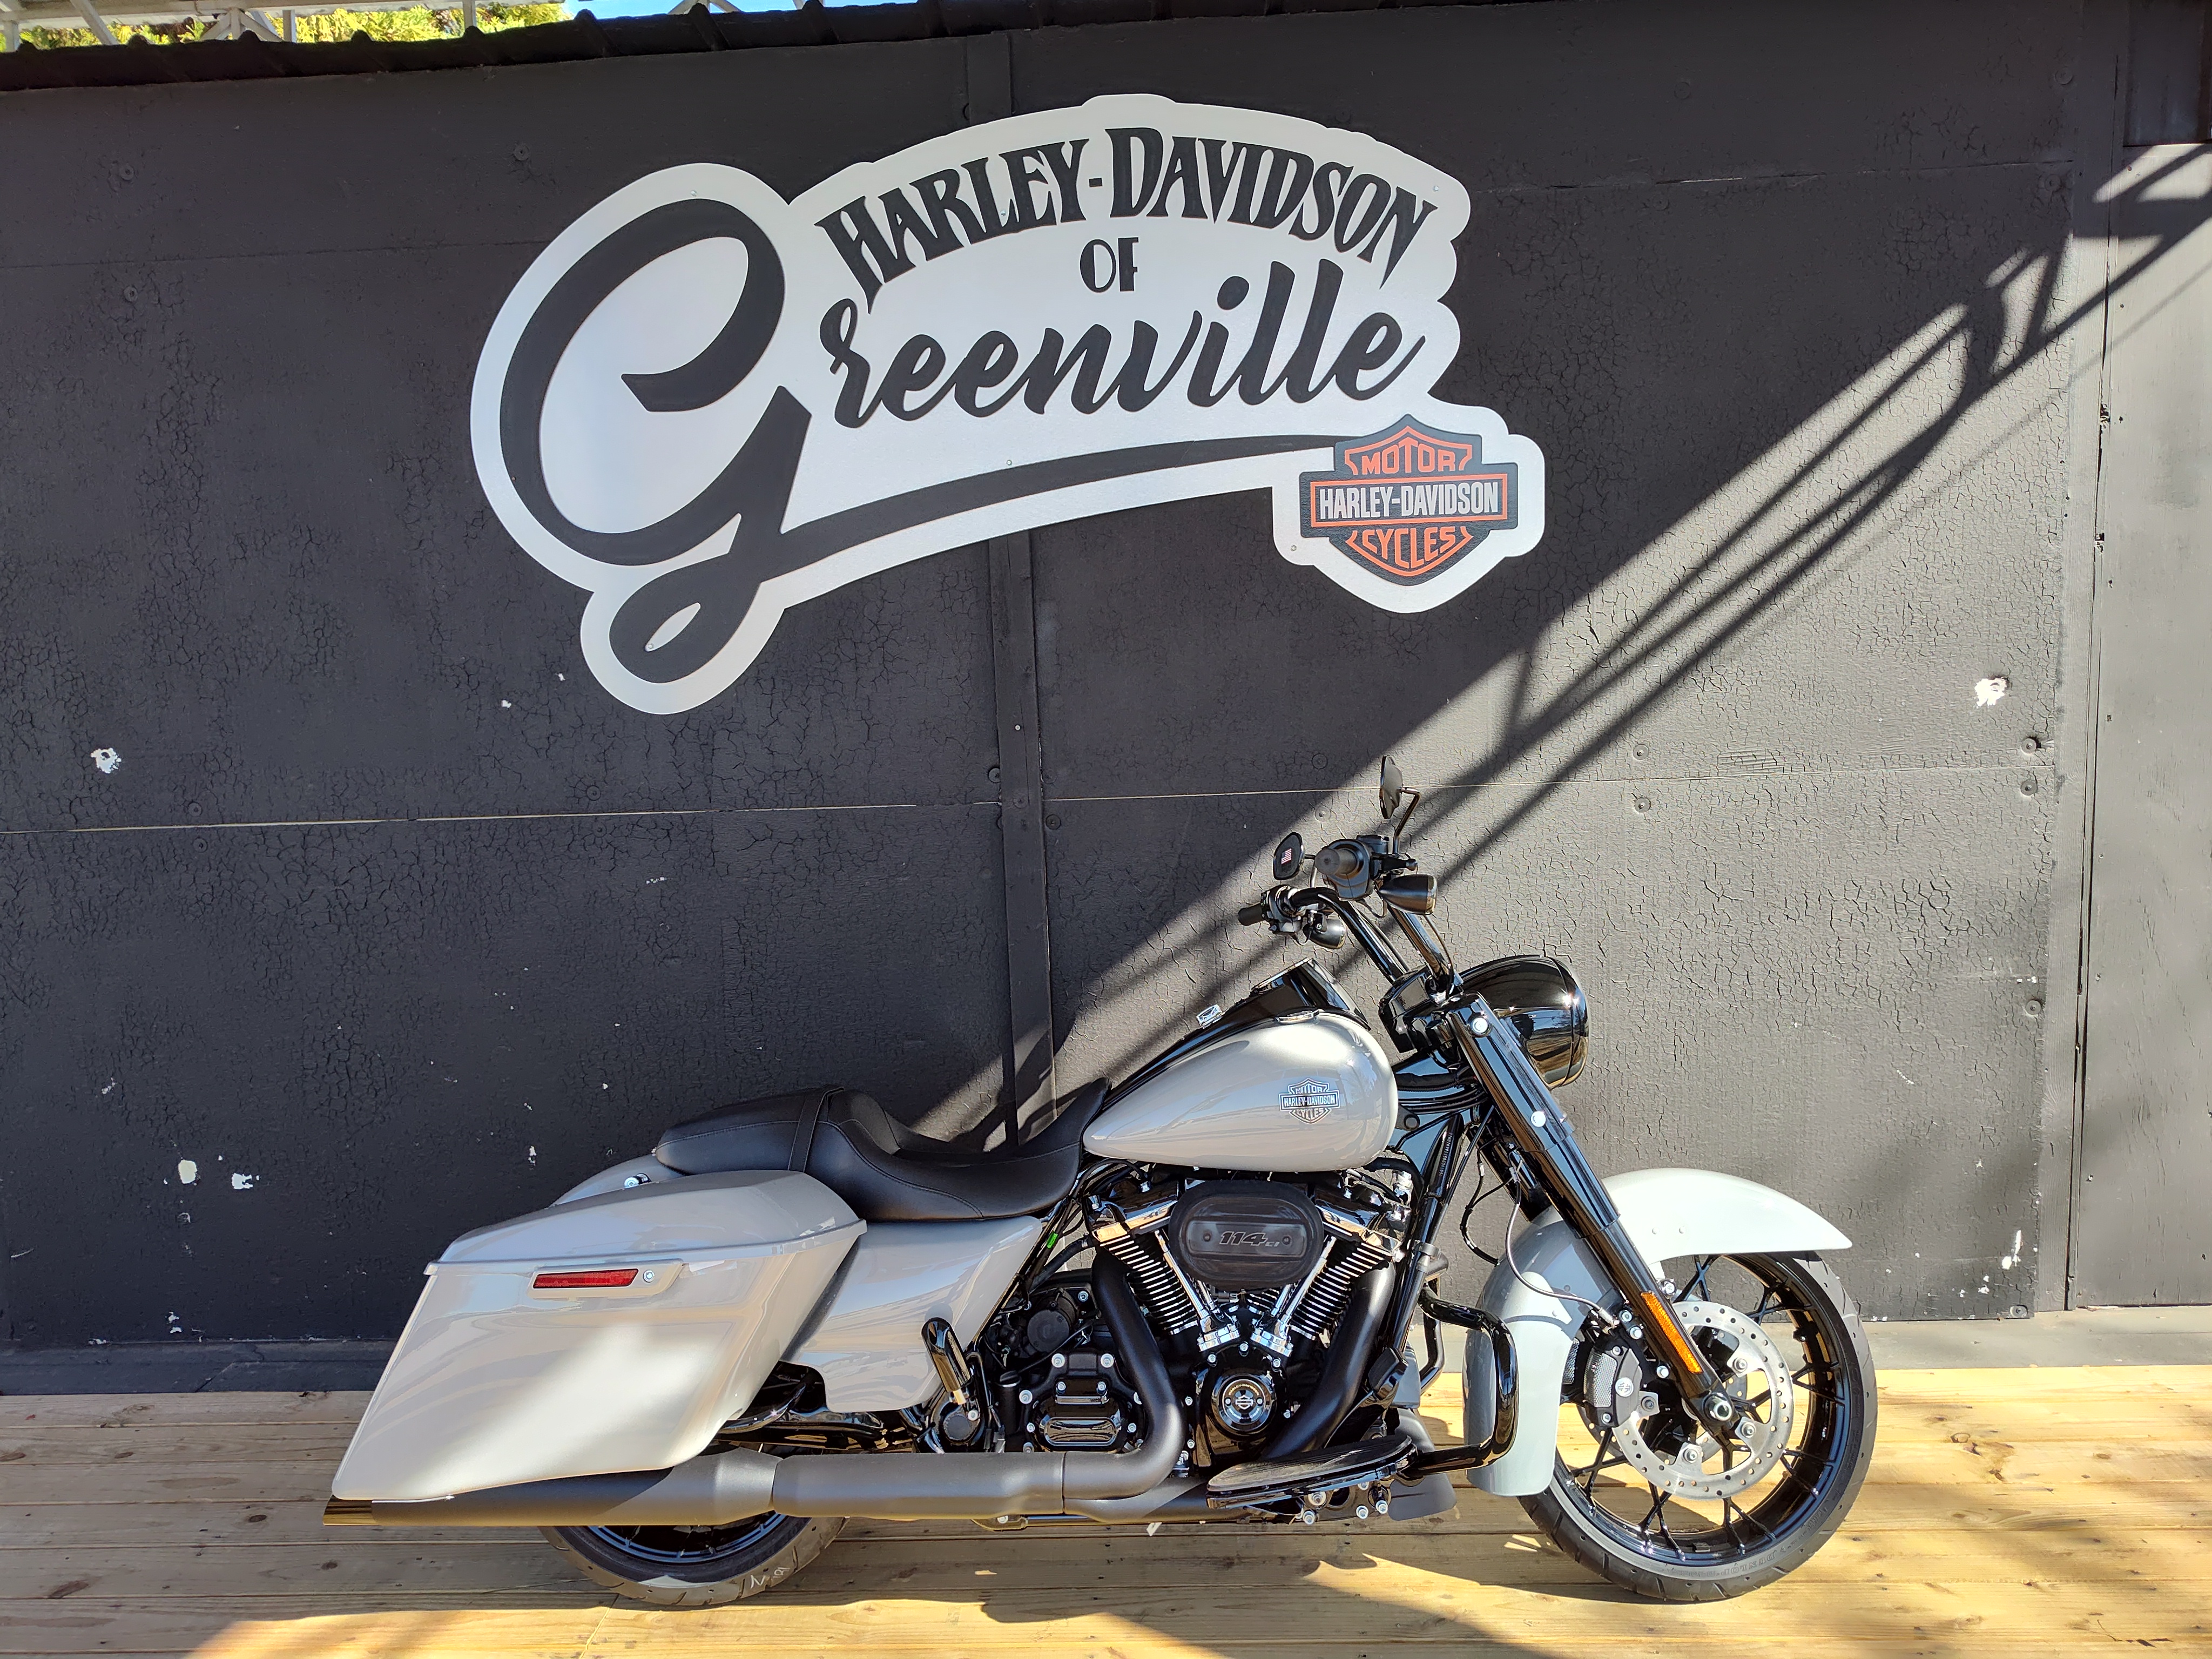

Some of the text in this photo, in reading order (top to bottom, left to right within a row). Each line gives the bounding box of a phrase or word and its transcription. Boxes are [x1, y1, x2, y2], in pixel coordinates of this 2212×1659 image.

[814, 127, 1438, 314] HARLEY-DAVIDSON
[1080, 237, 1138, 293] OF
[500, 199, 1426, 683] Greenville
[1361, 436, 1456, 475] MOTOR
[1319, 481, 1499, 520] HARLEY-DAVIDSON
[1362, 526, 1456, 569] CYCLES
[1284, 1095, 1336, 1107] HARLEY-DAVIDSON
[1295, 1083, 1323, 1095] MOTOR
[1296, 1108, 1324, 1121] CYCLES
[1219, 1231, 1269, 1246] 114
